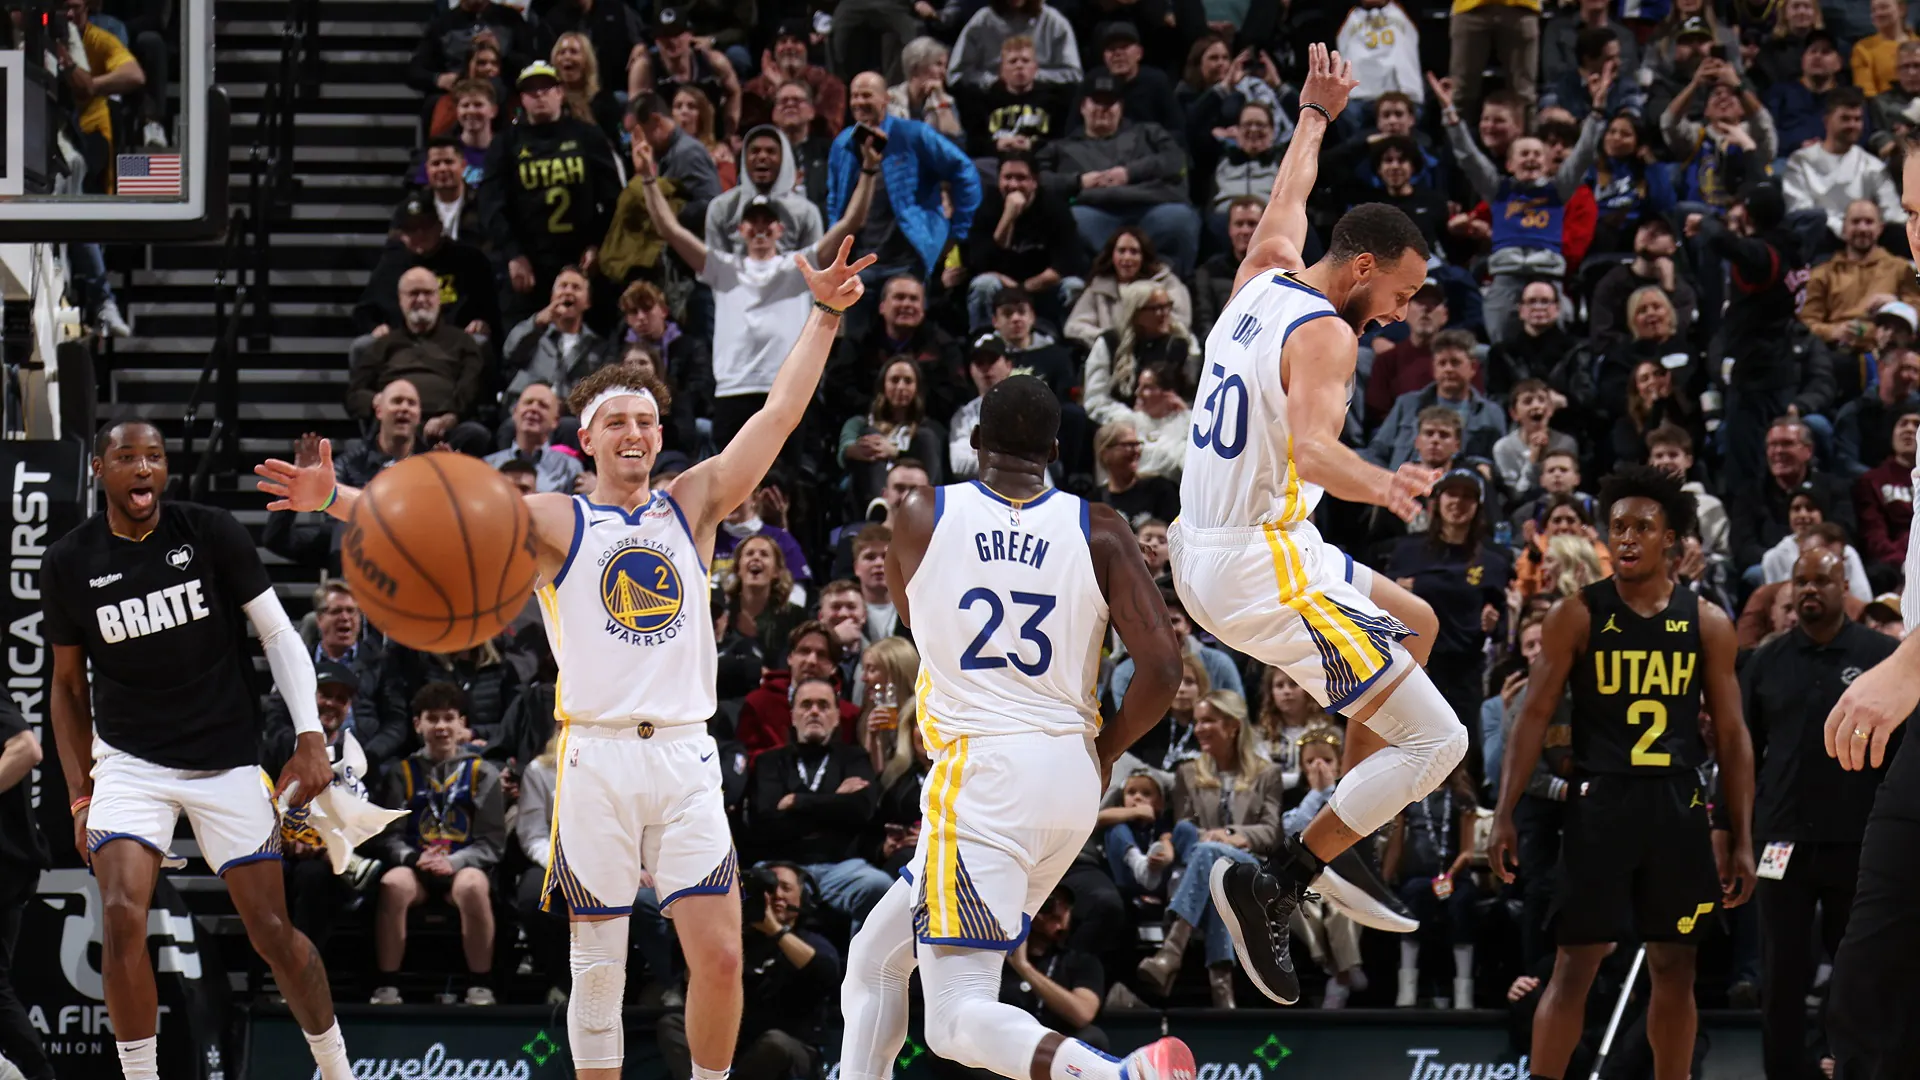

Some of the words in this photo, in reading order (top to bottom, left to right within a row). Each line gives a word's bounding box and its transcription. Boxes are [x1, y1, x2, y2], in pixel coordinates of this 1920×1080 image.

[519, 155, 585, 190] UTAH
[545, 186, 573, 233] 2
[1193, 362, 1249, 460] 30
[10, 461, 51, 600] FIRST
[975, 530, 1050, 570] GREEN
[597, 537, 639, 567] GOLDEN
[643, 538, 676, 560] STATE
[89, 572, 123, 588] Rakuten
[654, 565, 670, 590] 2
[96, 578, 211, 645] BRATE
[605, 611, 687, 647] WARRIORS
[1665, 619, 1690, 633] LVT
[958, 587, 1057, 677] 23
[1595, 650, 1697, 696] UTAH
[1627, 699, 1672, 767] 2
[43, 1042, 101, 1055] NION
